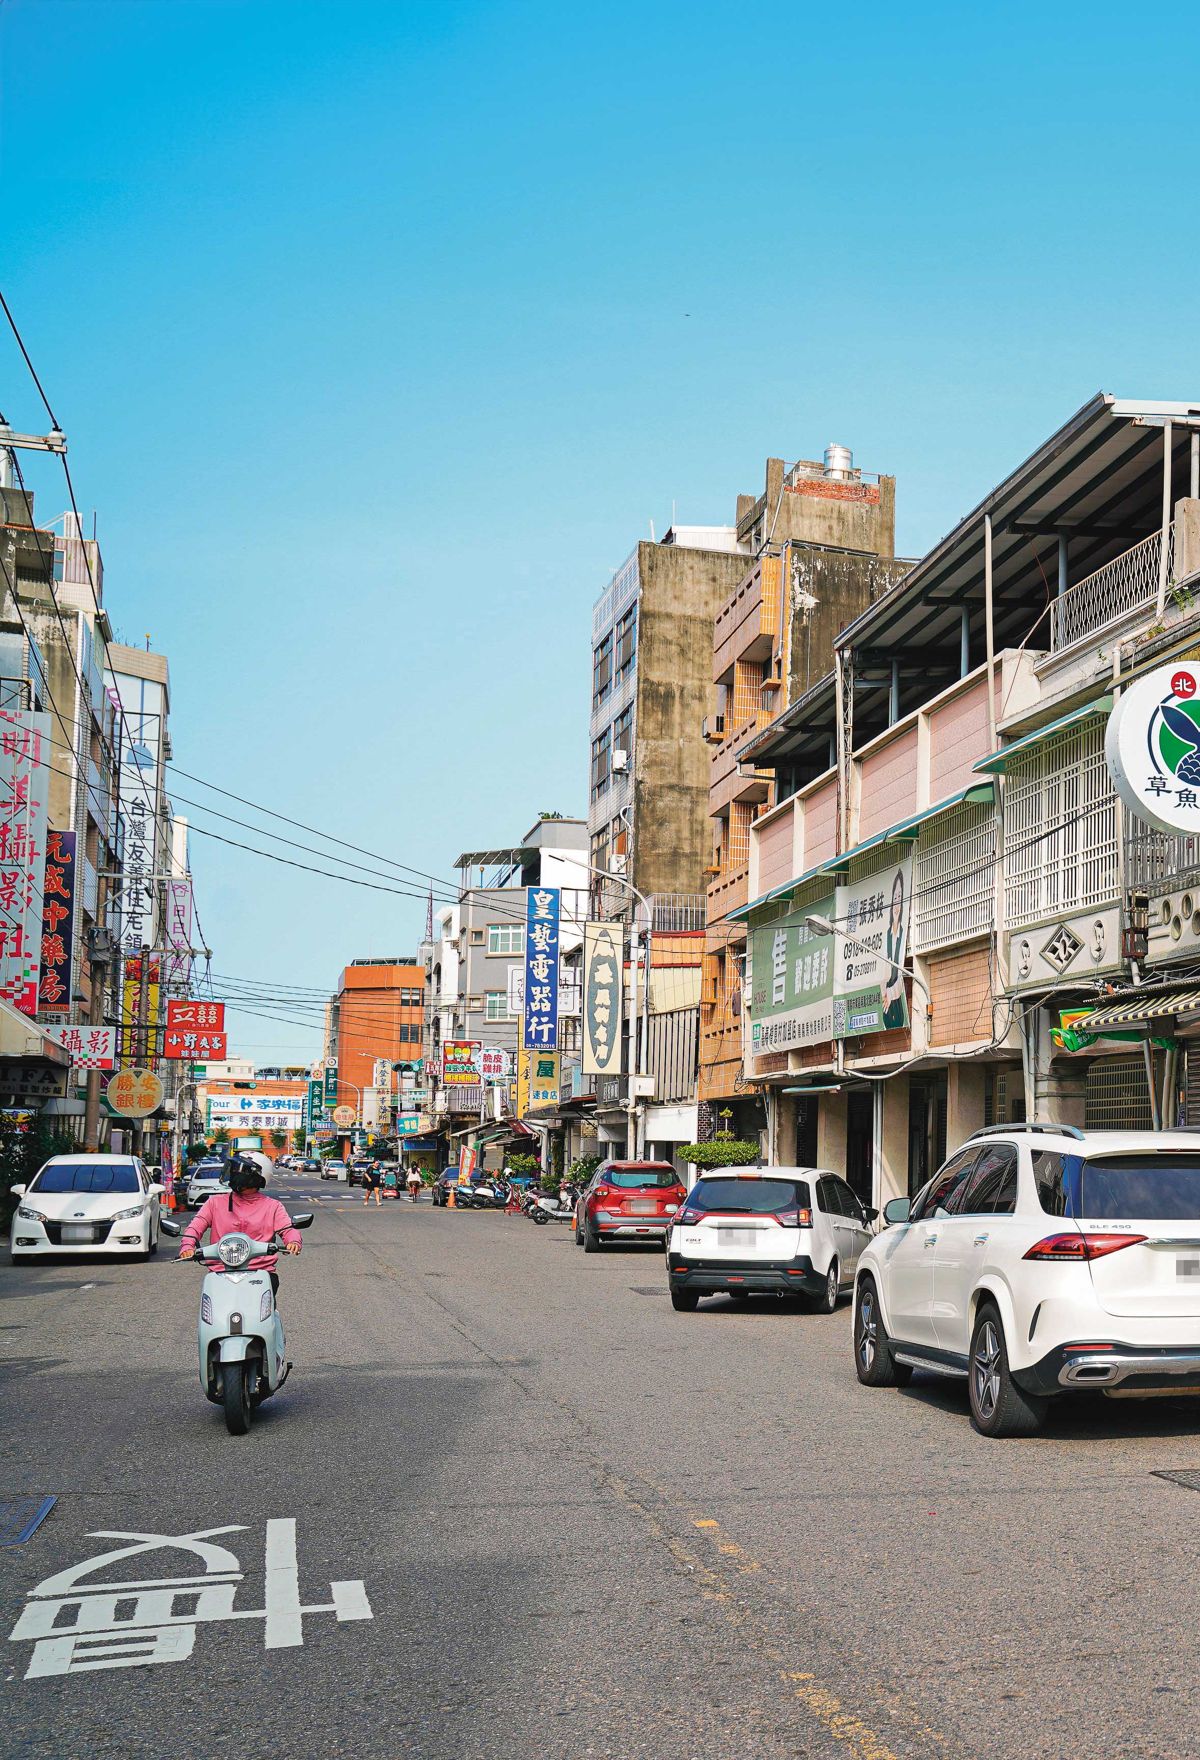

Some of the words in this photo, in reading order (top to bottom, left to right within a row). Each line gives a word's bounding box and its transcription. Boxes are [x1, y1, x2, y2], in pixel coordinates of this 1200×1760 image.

[527, 888, 558, 1043] 皇藝電器行
[45, 1028, 110, 1055] 攝影
